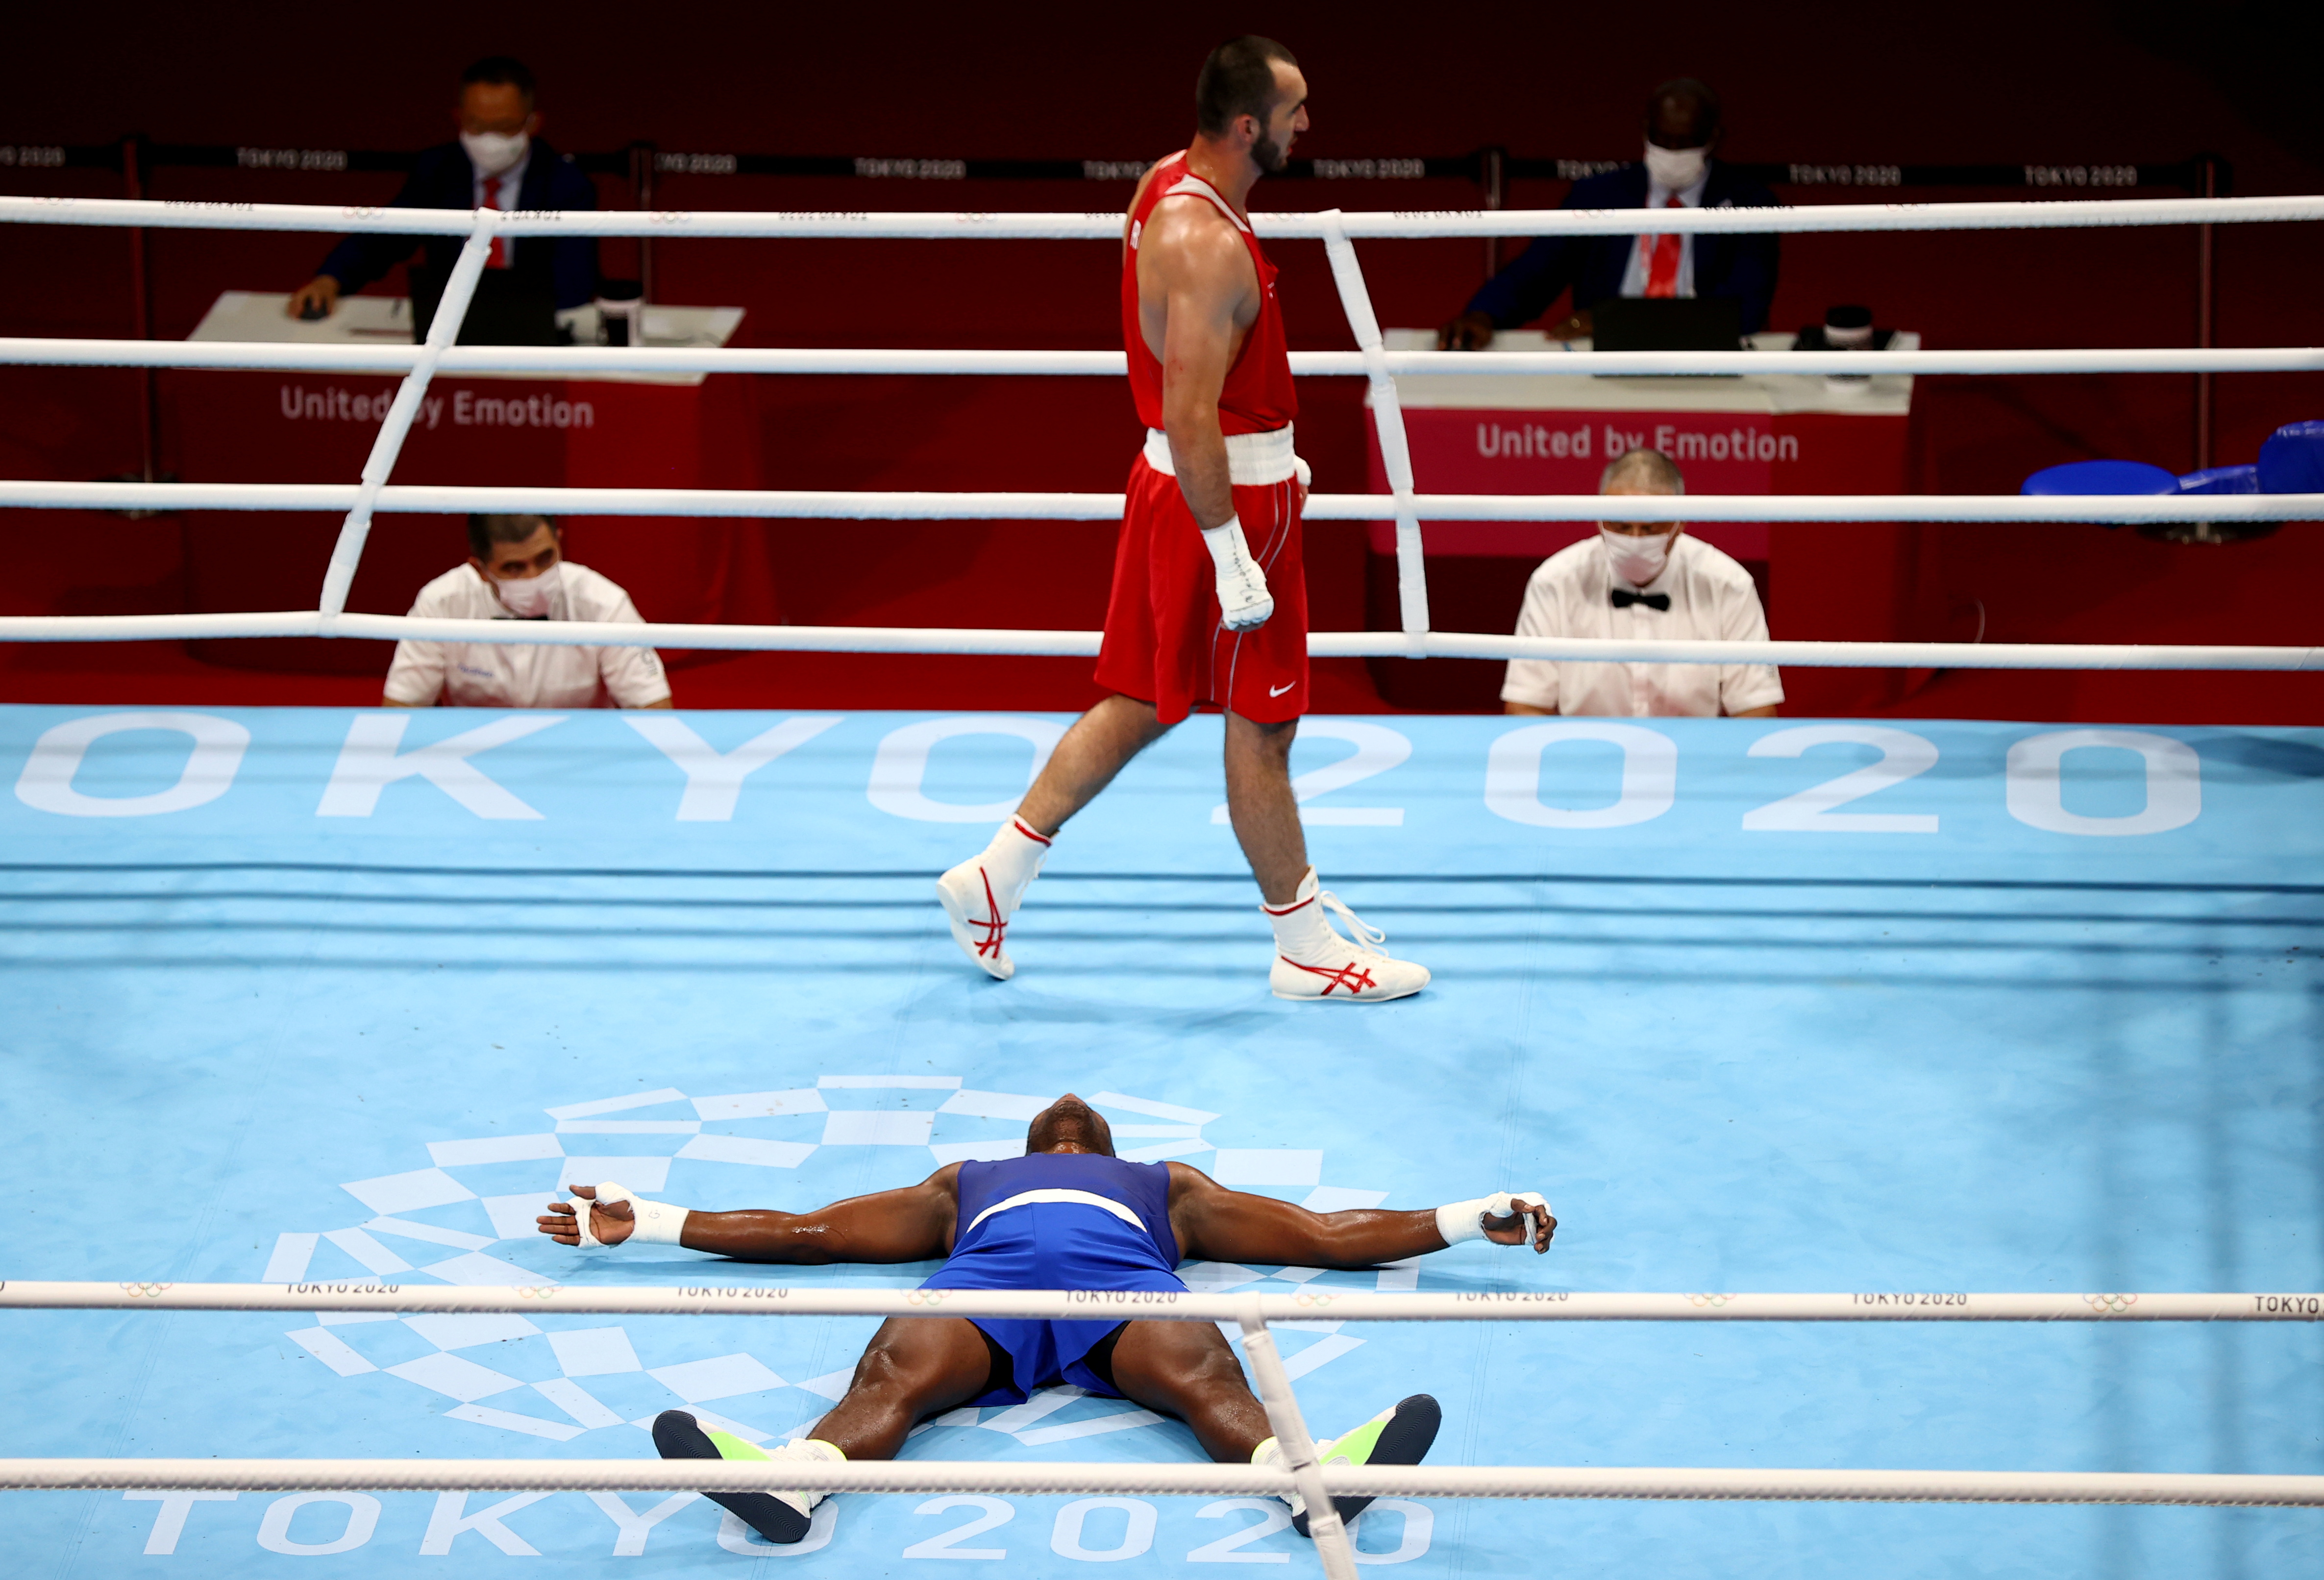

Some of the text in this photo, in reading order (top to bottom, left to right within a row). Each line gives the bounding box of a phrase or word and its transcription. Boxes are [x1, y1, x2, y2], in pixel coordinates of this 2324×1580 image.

[1789, 164, 1901, 186] TOKYO 2020
[2024, 165, 2137, 187] TOKYO 2020
[281, 385, 392, 421] United
[453, 390, 594, 428] Emotion
[1477, 423, 1591, 458] United
[1655, 425, 1798, 462] Emotion
[1211, 716, 2202, 837] 2020
[1066, 1289, 1177, 1304] TOKYO 2020
[2254, 1296, 2319, 1314] TOKYO
[121, 1491, 1435, 1565] TOKYO 2020
